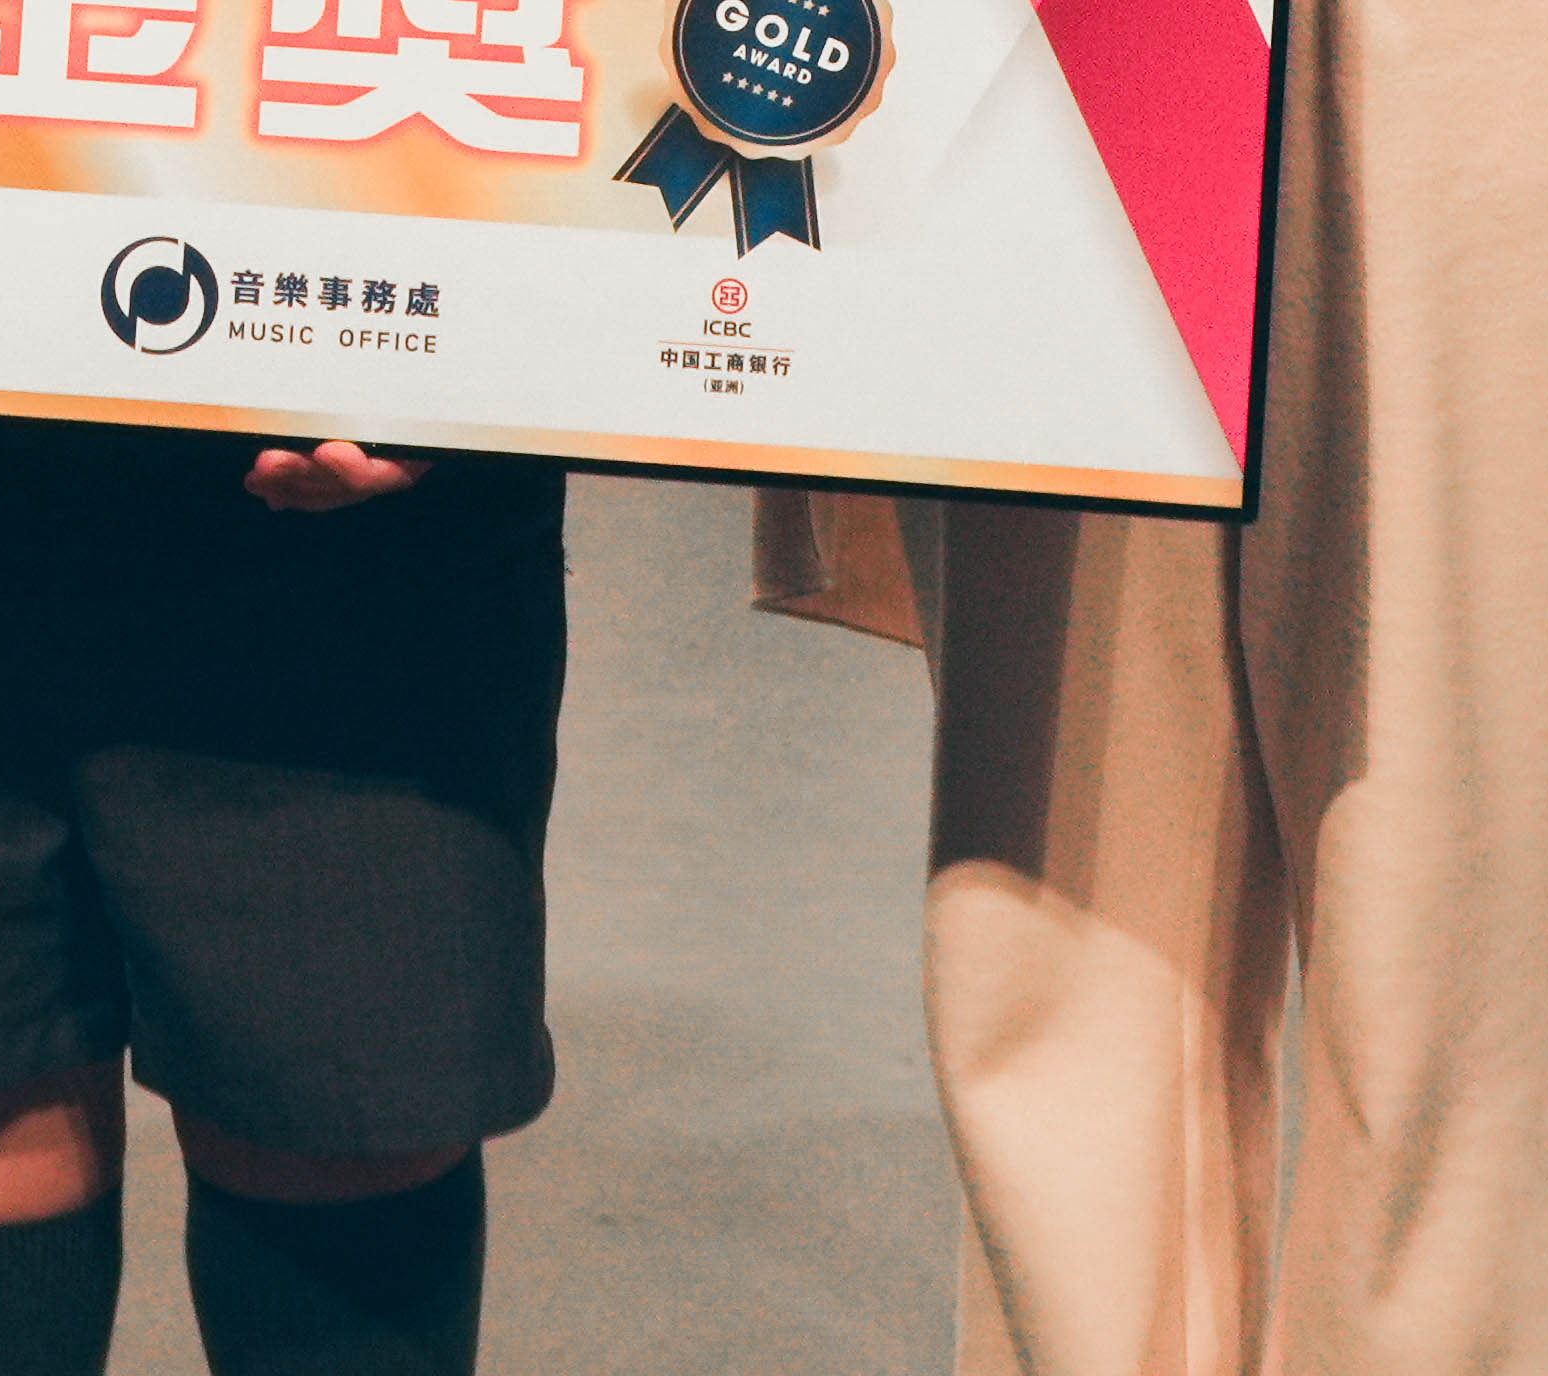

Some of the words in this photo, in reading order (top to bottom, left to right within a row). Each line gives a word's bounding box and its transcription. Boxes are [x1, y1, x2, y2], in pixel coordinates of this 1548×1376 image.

[716, 0, 849, 73] GOLD
[733, 45, 811, 83] AWARD
[231, 270, 440, 317] 音樂事務處
[229, 322, 312, 343] MUSIC
[340, 329, 435, 353] OFFICE
[703, 319, 752, 338] ICBC
